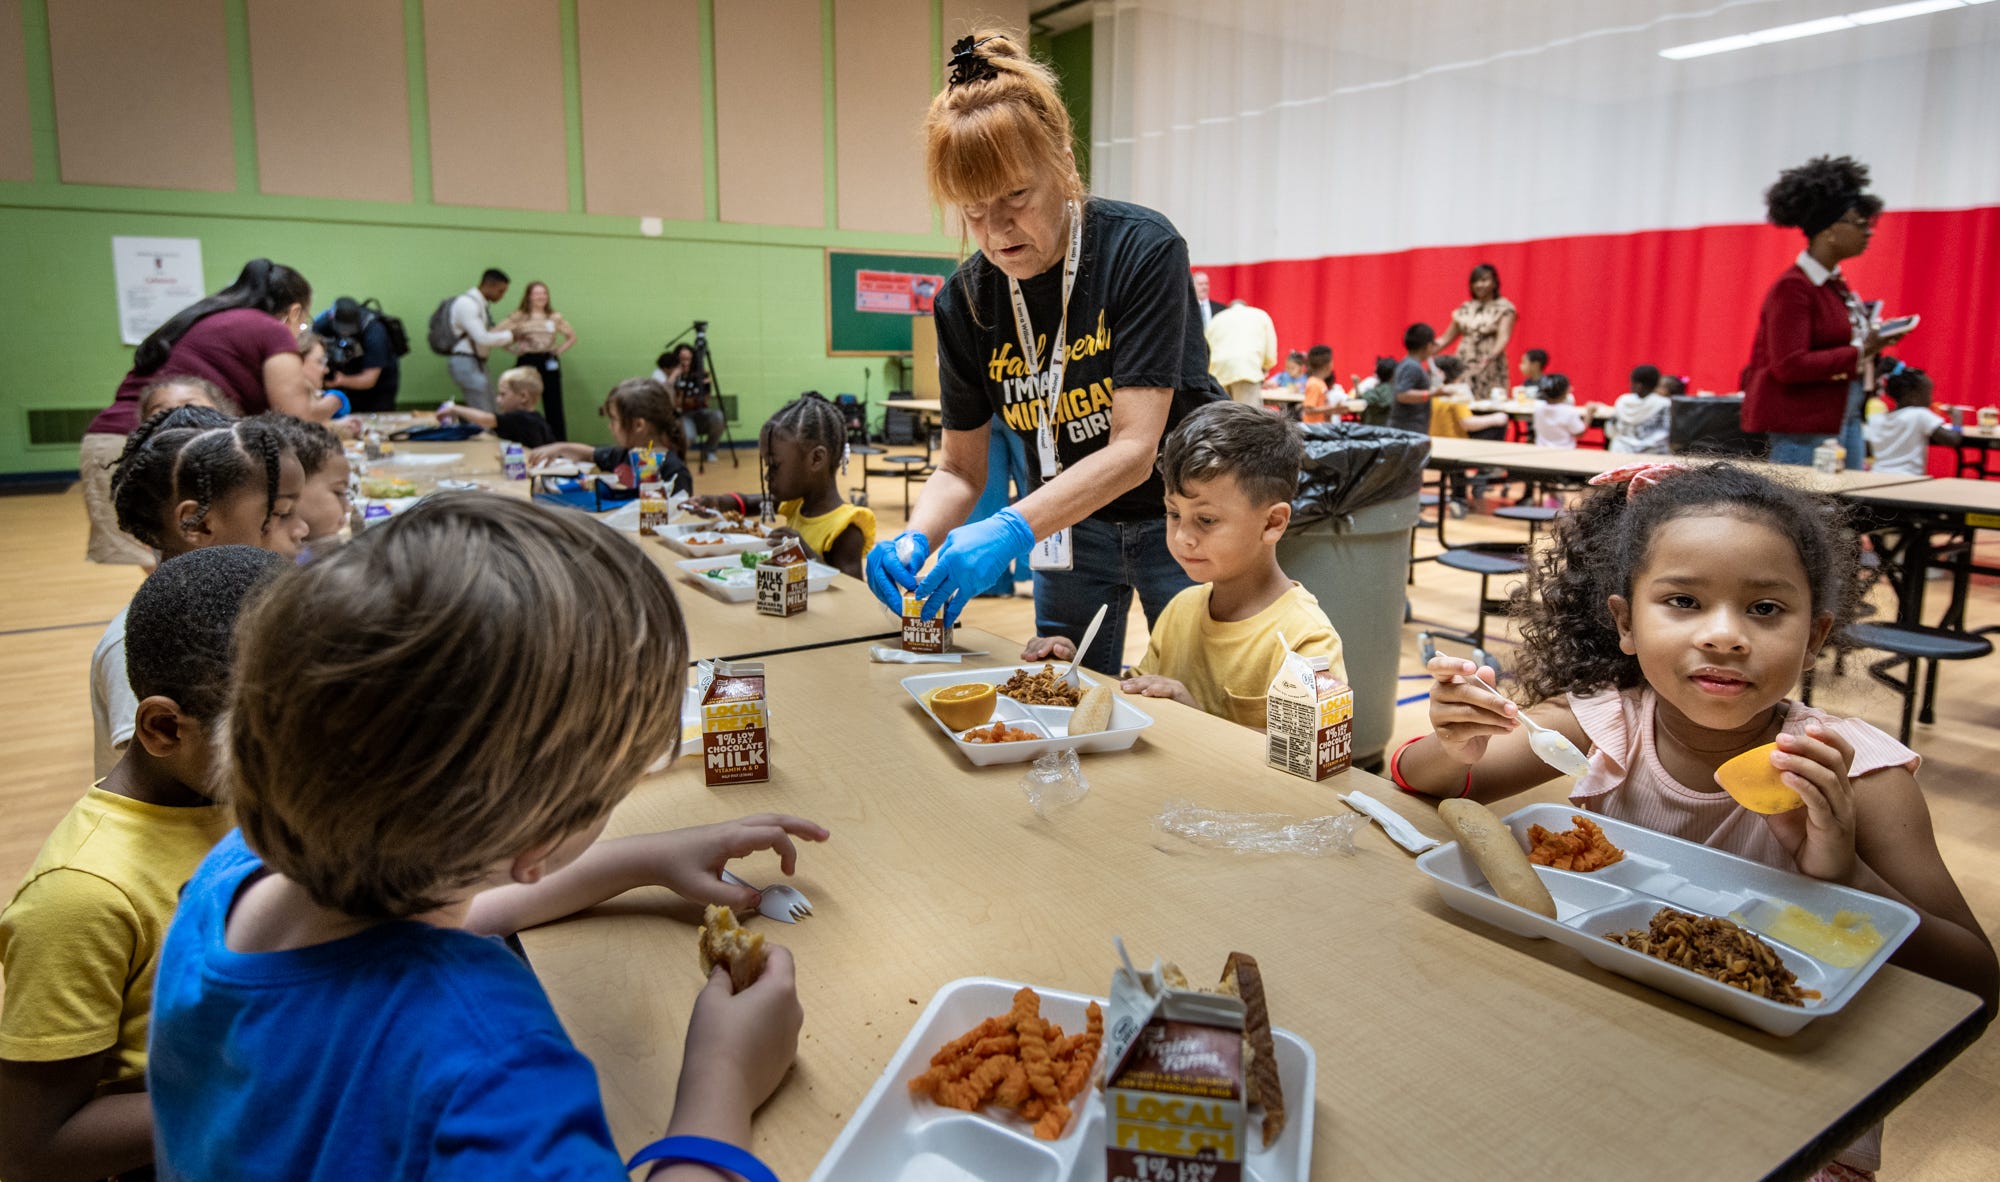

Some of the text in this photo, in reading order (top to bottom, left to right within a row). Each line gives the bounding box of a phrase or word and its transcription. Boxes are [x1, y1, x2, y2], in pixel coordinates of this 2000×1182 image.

[1017, 307, 1024, 317] am
[1021, 323, 1031, 345] Willow
[1027, 343, 1035, 366] Rhino!
[1003, 375, 1036, 404] I'M
[757, 570, 783, 583] MILK
[757, 580, 783, 592] FACT
[904, 631, 941, 644] MILK
[706, 702, 761, 718] LOCAL
[1320, 693, 1352, 714] LOCAL
[707, 715, 763, 733] FRESH
[1321, 705, 1352, 728] FRESH
[716, 731, 755, 746] 1% LOW
[1319, 732, 1352, 750] CHOCOLATE
[1325, 722, 1348, 741] 1% LOW
[707, 741, 764, 754] CHOCOLATE
[1319, 739, 1352, 766] MILK
[707, 748, 766, 769] MILK
[1115, 1094, 1233, 1130] LOCAL
[1115, 1121, 1236, 1161] FRESH
[1132, 1154, 1218, 1182] 1% LOW
